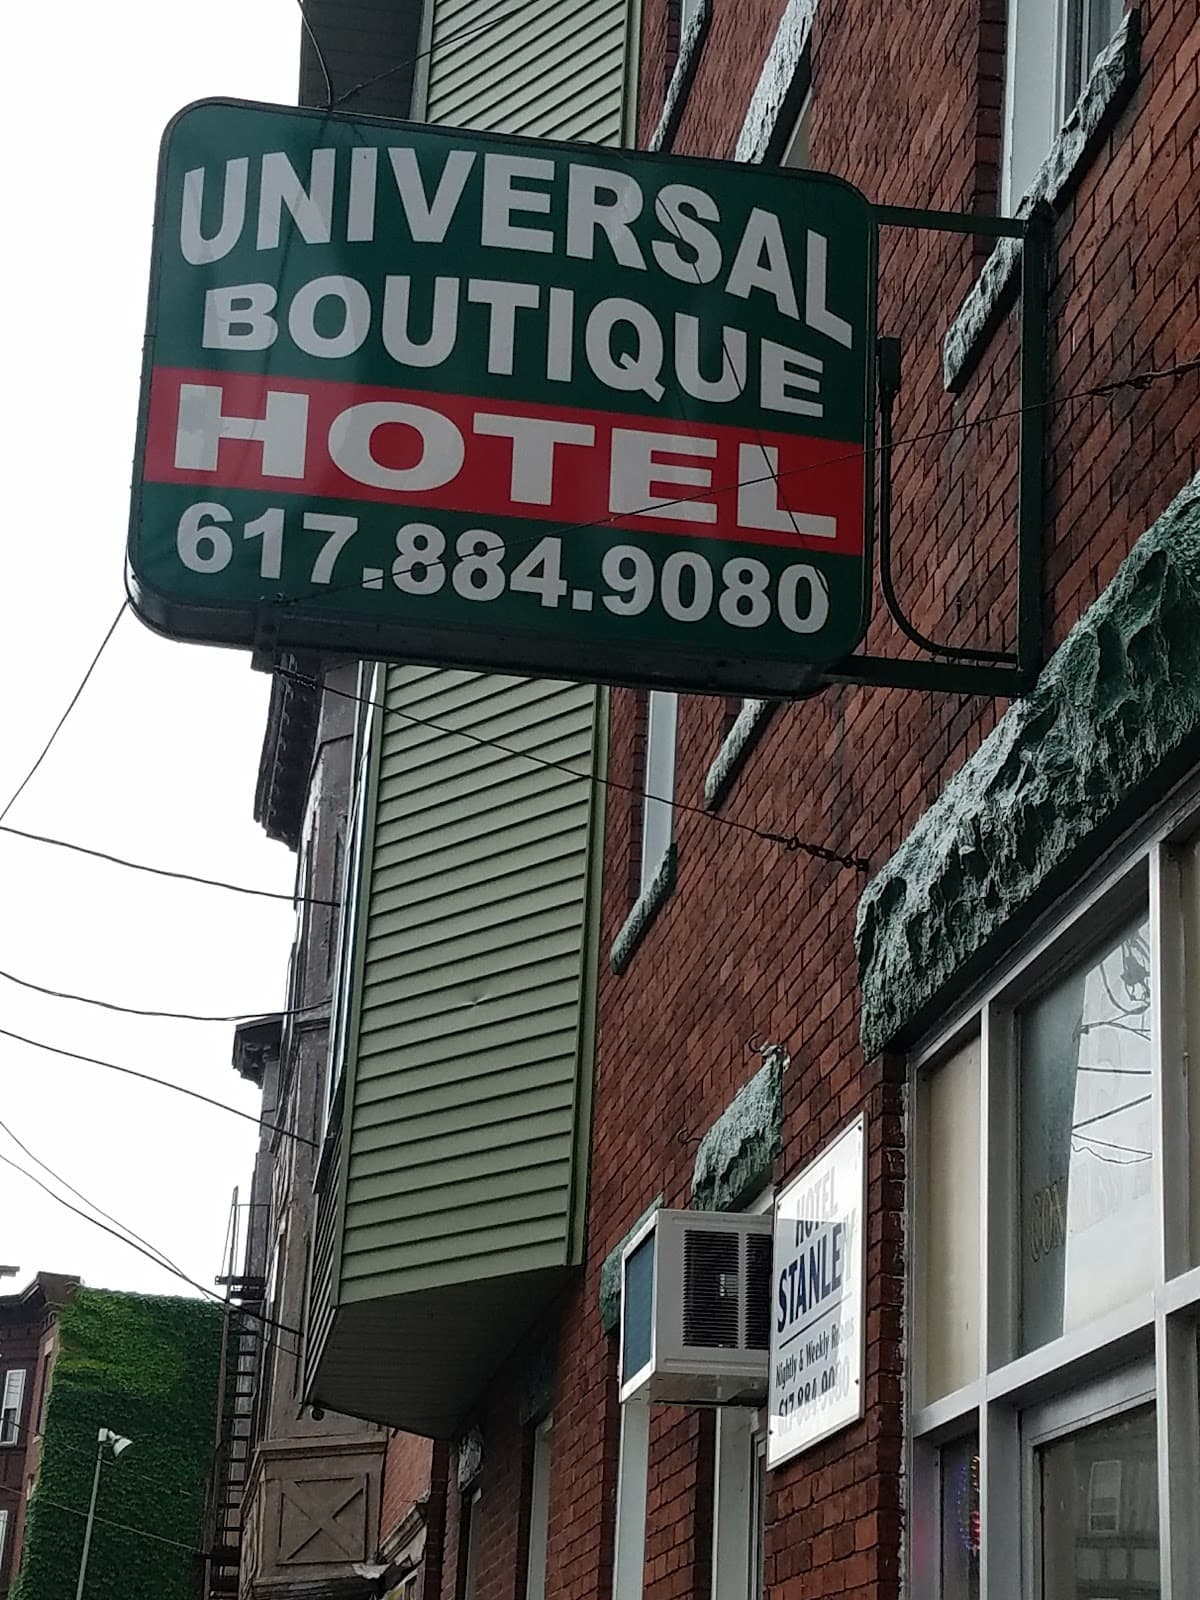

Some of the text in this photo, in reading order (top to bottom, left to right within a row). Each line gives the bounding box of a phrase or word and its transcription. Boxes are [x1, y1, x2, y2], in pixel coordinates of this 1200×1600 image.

[179, 147, 853, 348] UNIVERSAL
[202, 275, 824, 418] BOUTIQUE
[174, 383, 838, 539] HOTEL
[176, 502, 830, 634] 617.884.9080
[795, 1166, 838, 1248] HOTEL
[776, 1354, 798, 1389] Nightly
[799, 1348, 805, 1371] &
[806, 1330, 829, 1367] Weekly
